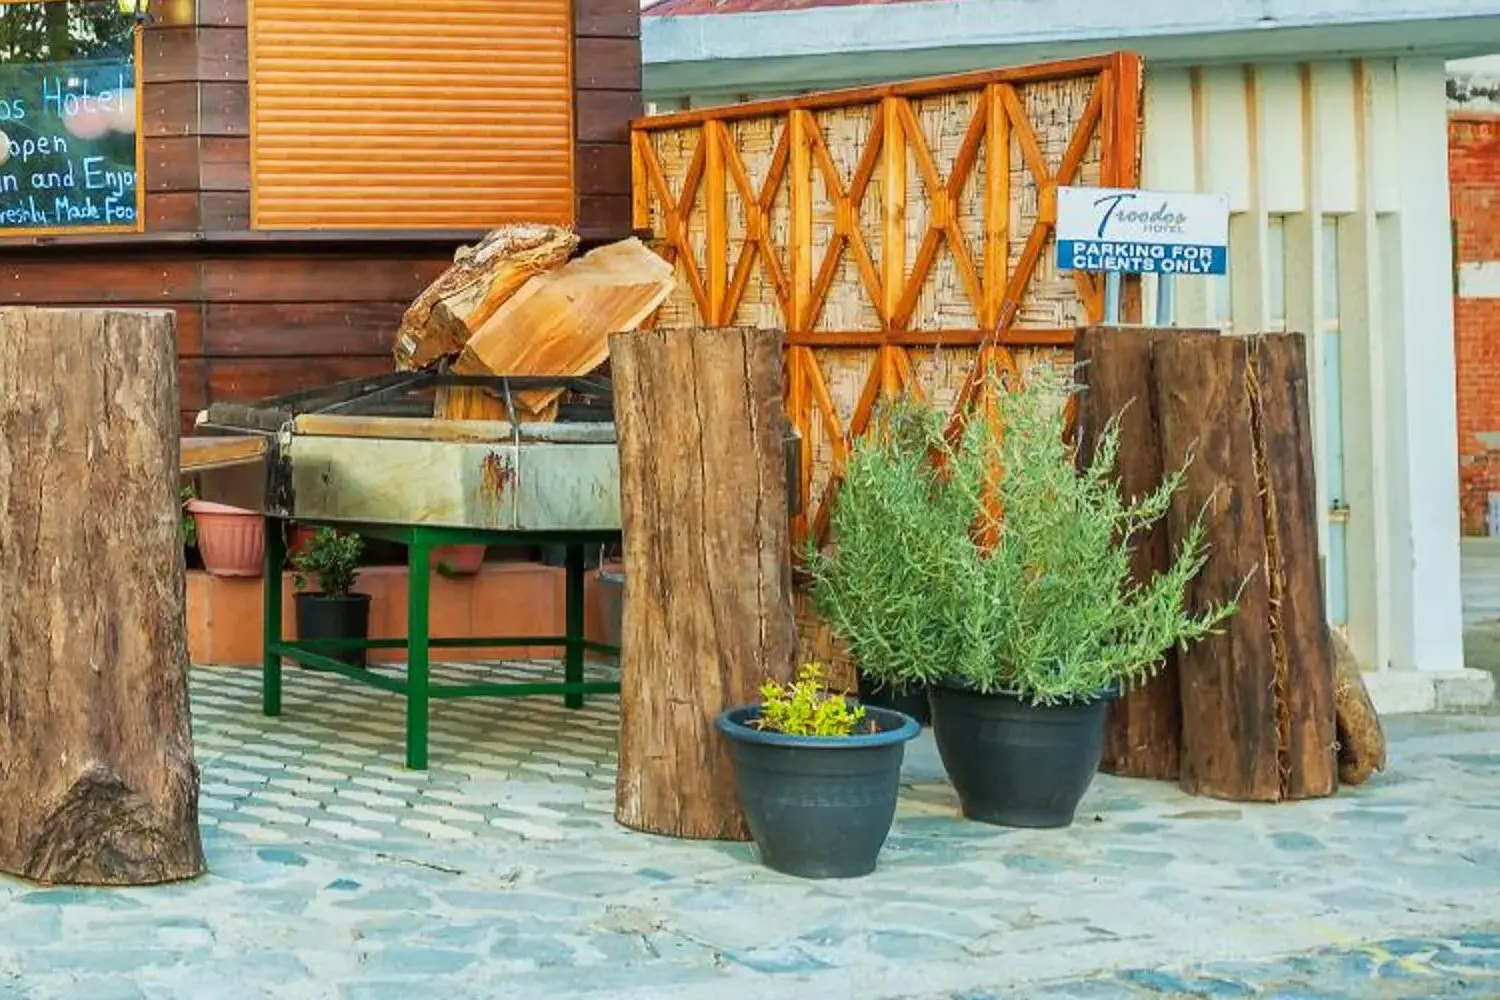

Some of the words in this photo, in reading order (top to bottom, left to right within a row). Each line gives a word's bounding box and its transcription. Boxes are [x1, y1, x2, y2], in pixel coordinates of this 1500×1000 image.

[43, 73, 123, 118] Hotel
[9, 135, 68, 162] open
[31, 160, 75, 189] and
[83, 156, 137, 197] Enjo
[105, 197, 137, 225] Foo
[1093, 193, 1188, 239] Troodos
[1143, 224, 1185, 233] HOTEL
[1073, 242, 1165, 258] PARKING
[1172, 246, 1213, 260] FOR
[1073, 256, 1155, 271] CLIENTS
[1160, 258, 1213, 272] ONLY
